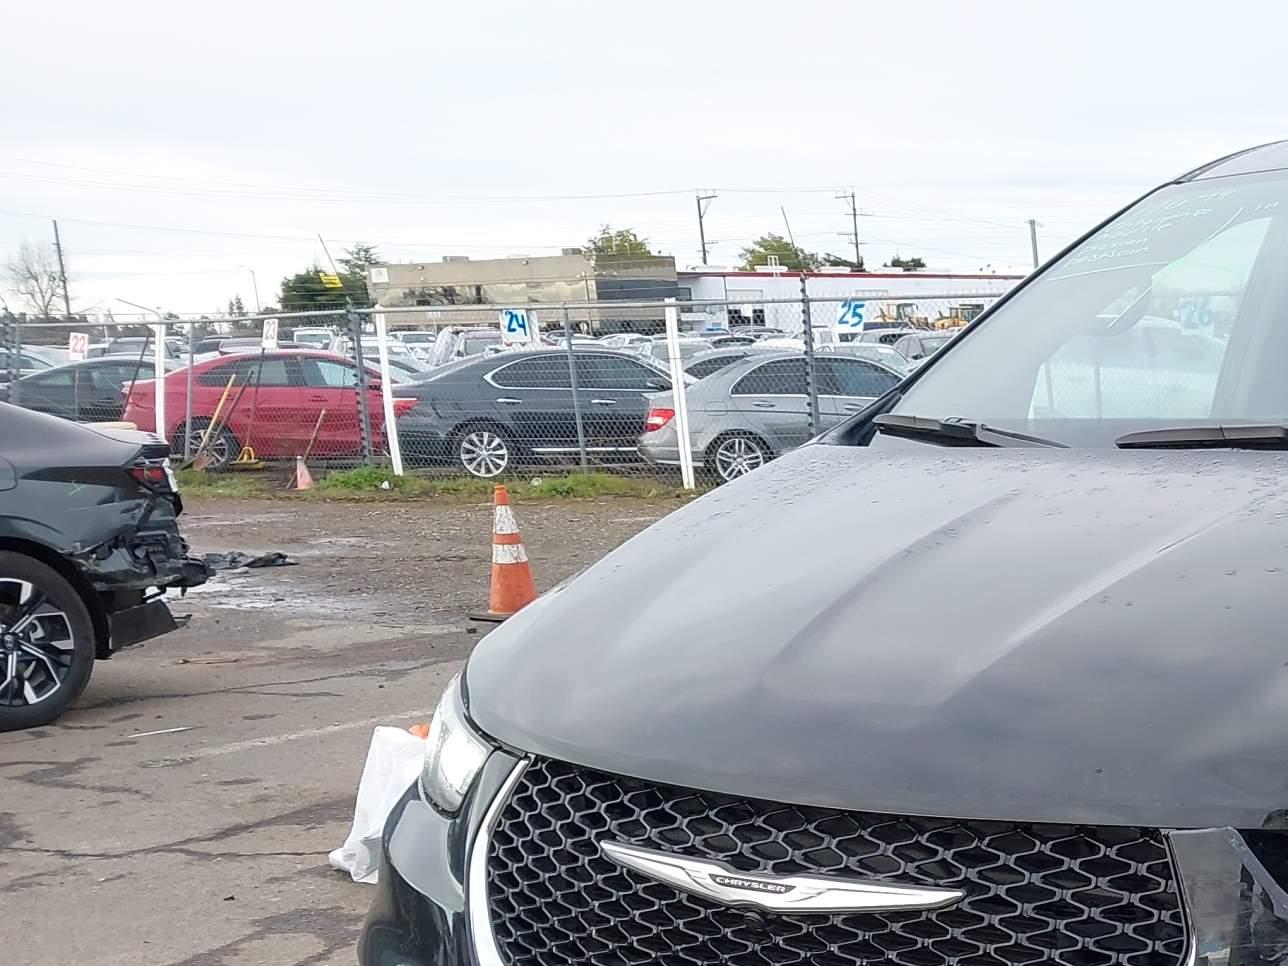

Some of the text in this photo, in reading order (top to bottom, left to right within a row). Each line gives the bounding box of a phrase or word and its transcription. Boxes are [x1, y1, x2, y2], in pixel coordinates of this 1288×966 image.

[838, 298, 864, 327] 25
[265, 320, 276, 340] 23
[505, 311, 527, 336] 24
[71, 335, 86, 353] 22
[716, 878, 786, 892] CHRYSLER
